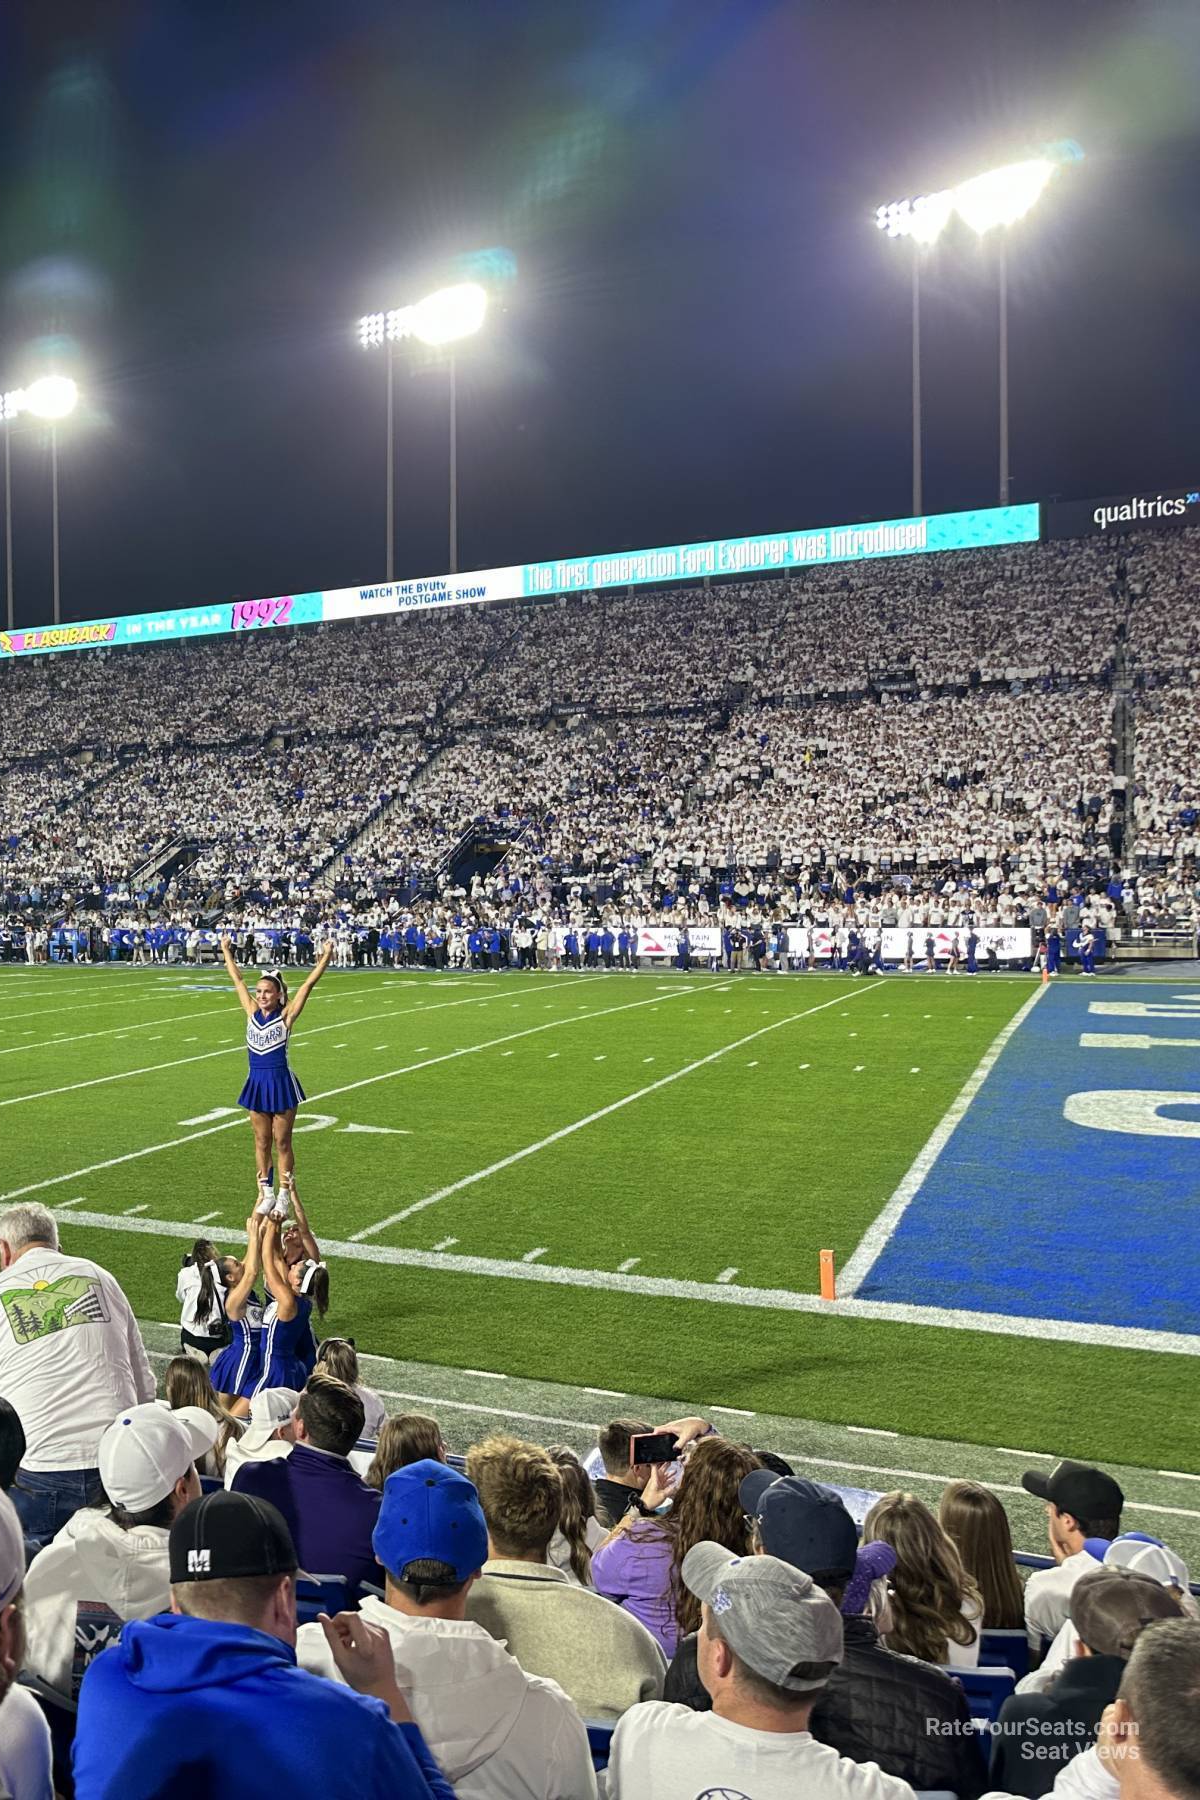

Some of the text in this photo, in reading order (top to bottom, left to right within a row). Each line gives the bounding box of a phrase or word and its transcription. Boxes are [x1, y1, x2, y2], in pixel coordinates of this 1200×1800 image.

[1094, 495, 1186, 530] qualtrics
[528, 565, 553, 592] The
[556, 560, 591, 588] first
[593, 552, 676, 586] generation
[679, 544, 715, 574] Ford
[718, 536, 789, 572] Explorer
[792, 532, 827, 561] was
[360, 581, 447, 600] WATCH THE BYUtv
[399, 586, 487, 606] POSTGAME SHOW
[23, 596, 293, 650] FLASHBACK IN THE YEAR 1992
[663, 934, 710, 942] MOTAIN
[248, 1026, 283, 1047] OUGARS
